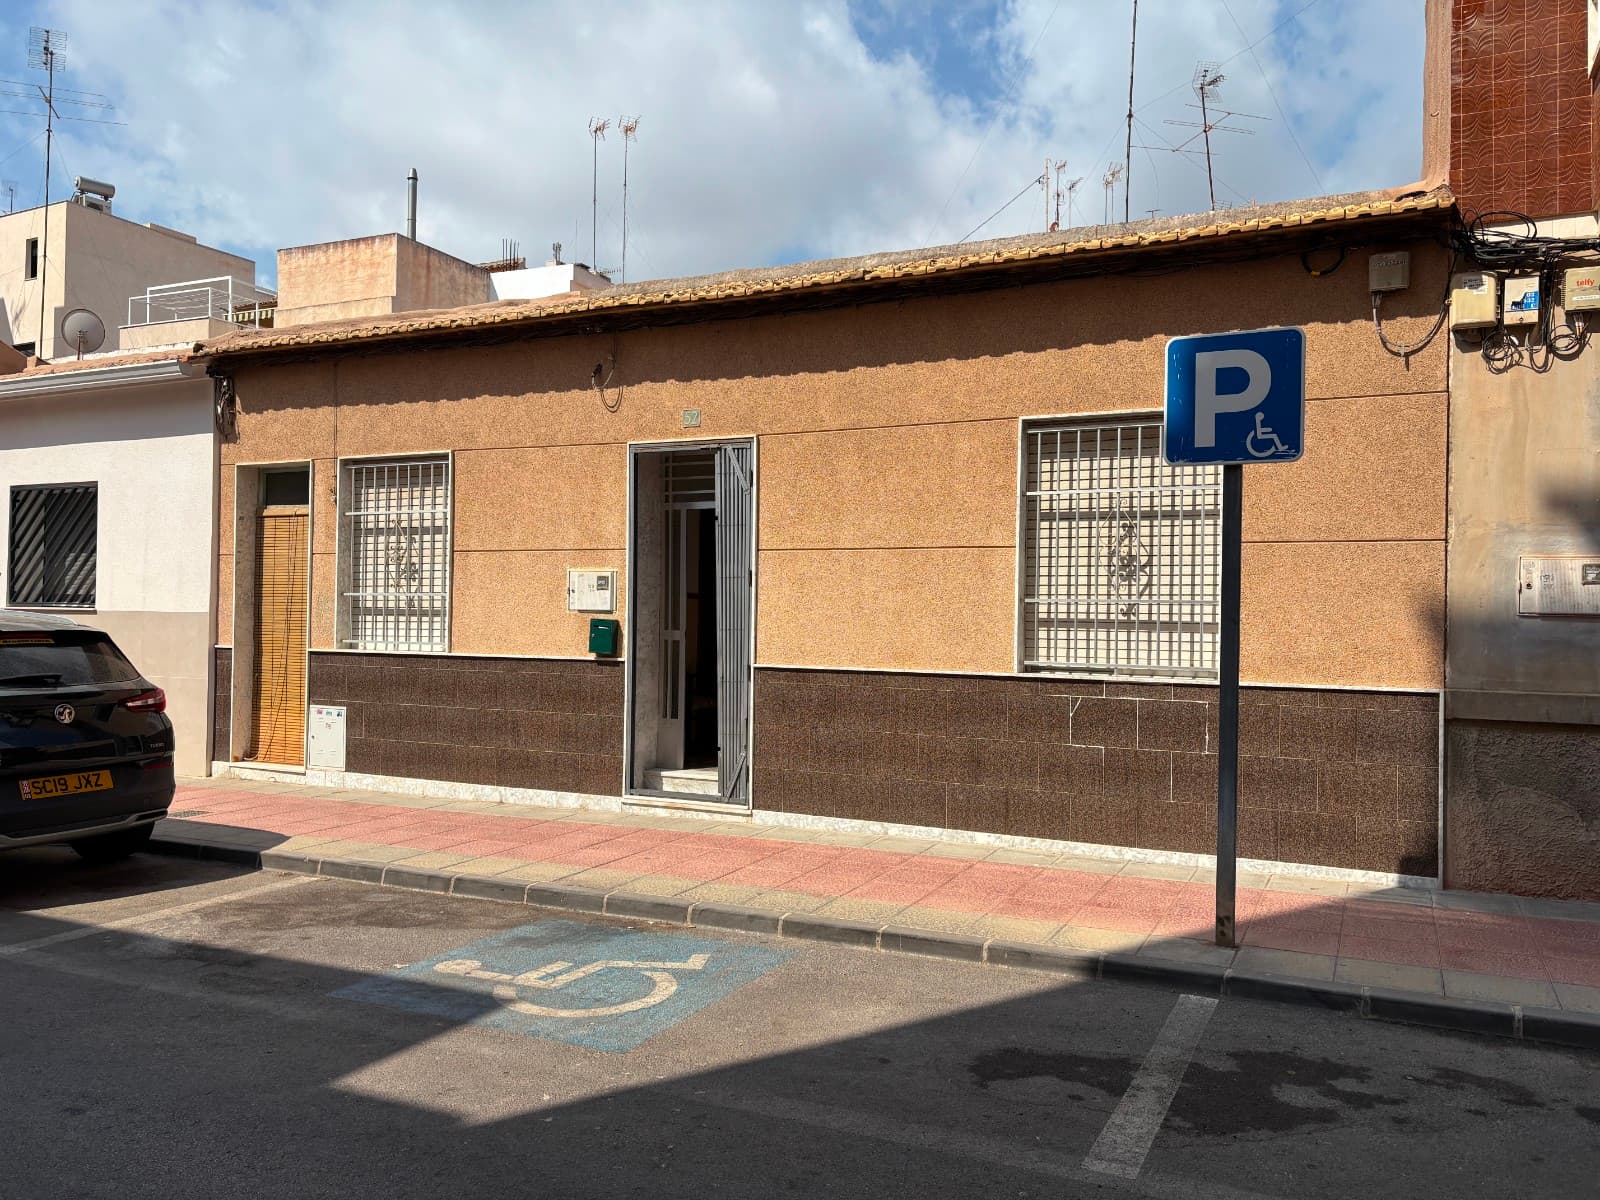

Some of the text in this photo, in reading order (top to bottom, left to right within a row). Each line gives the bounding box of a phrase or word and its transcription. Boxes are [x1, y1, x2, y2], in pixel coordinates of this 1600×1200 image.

[1194, 349, 1272, 448] P
[31, 773, 103, 796] SC19 JXZ
